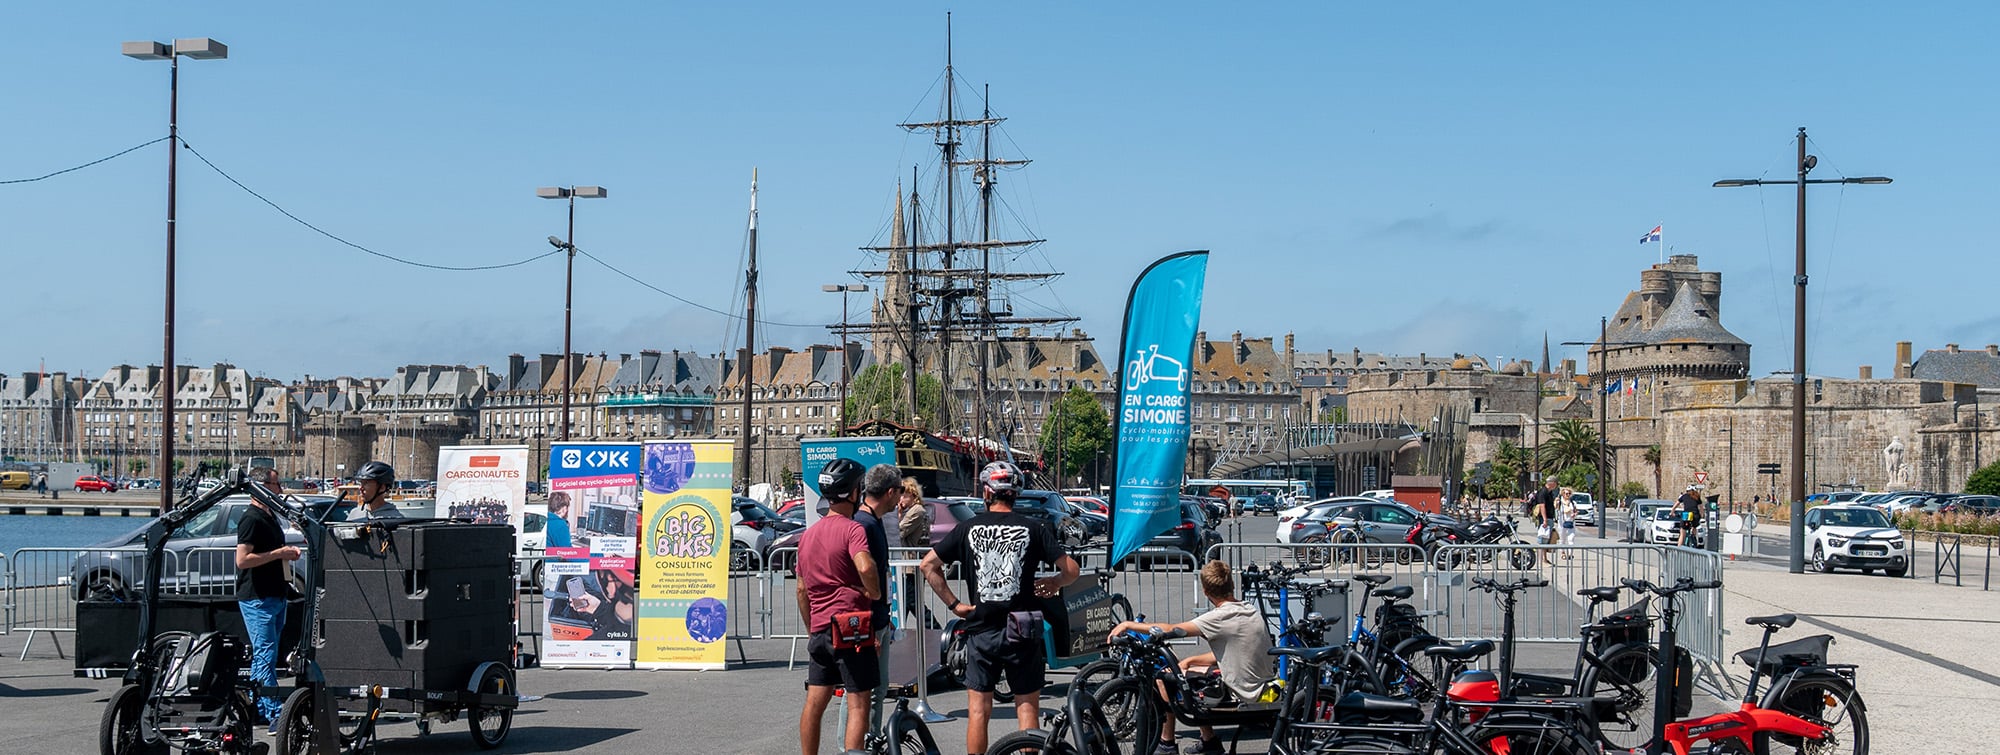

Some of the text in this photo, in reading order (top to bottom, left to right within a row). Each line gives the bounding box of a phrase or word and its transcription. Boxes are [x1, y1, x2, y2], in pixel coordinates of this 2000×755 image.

[1125, 394, 1187, 407] EN CARGO
[1124, 408, 1186, 424] SIMONE
[1122, 426, 1186, 435] Cyclo-mobilité
[585, 450, 630, 468] CYKE
[806, 453, 838, 461] SIMONE
[445, 470, 520, 479] CARGONAUTES
[555, 480, 578, 488] Logiciel
[586, 477, 633, 487] cyclo-logistique
[655, 561, 713, 569] CONSULTING
[1086, 607, 1110, 620] EN CARGO
[1086, 619, 1110, 634] SIMONE
